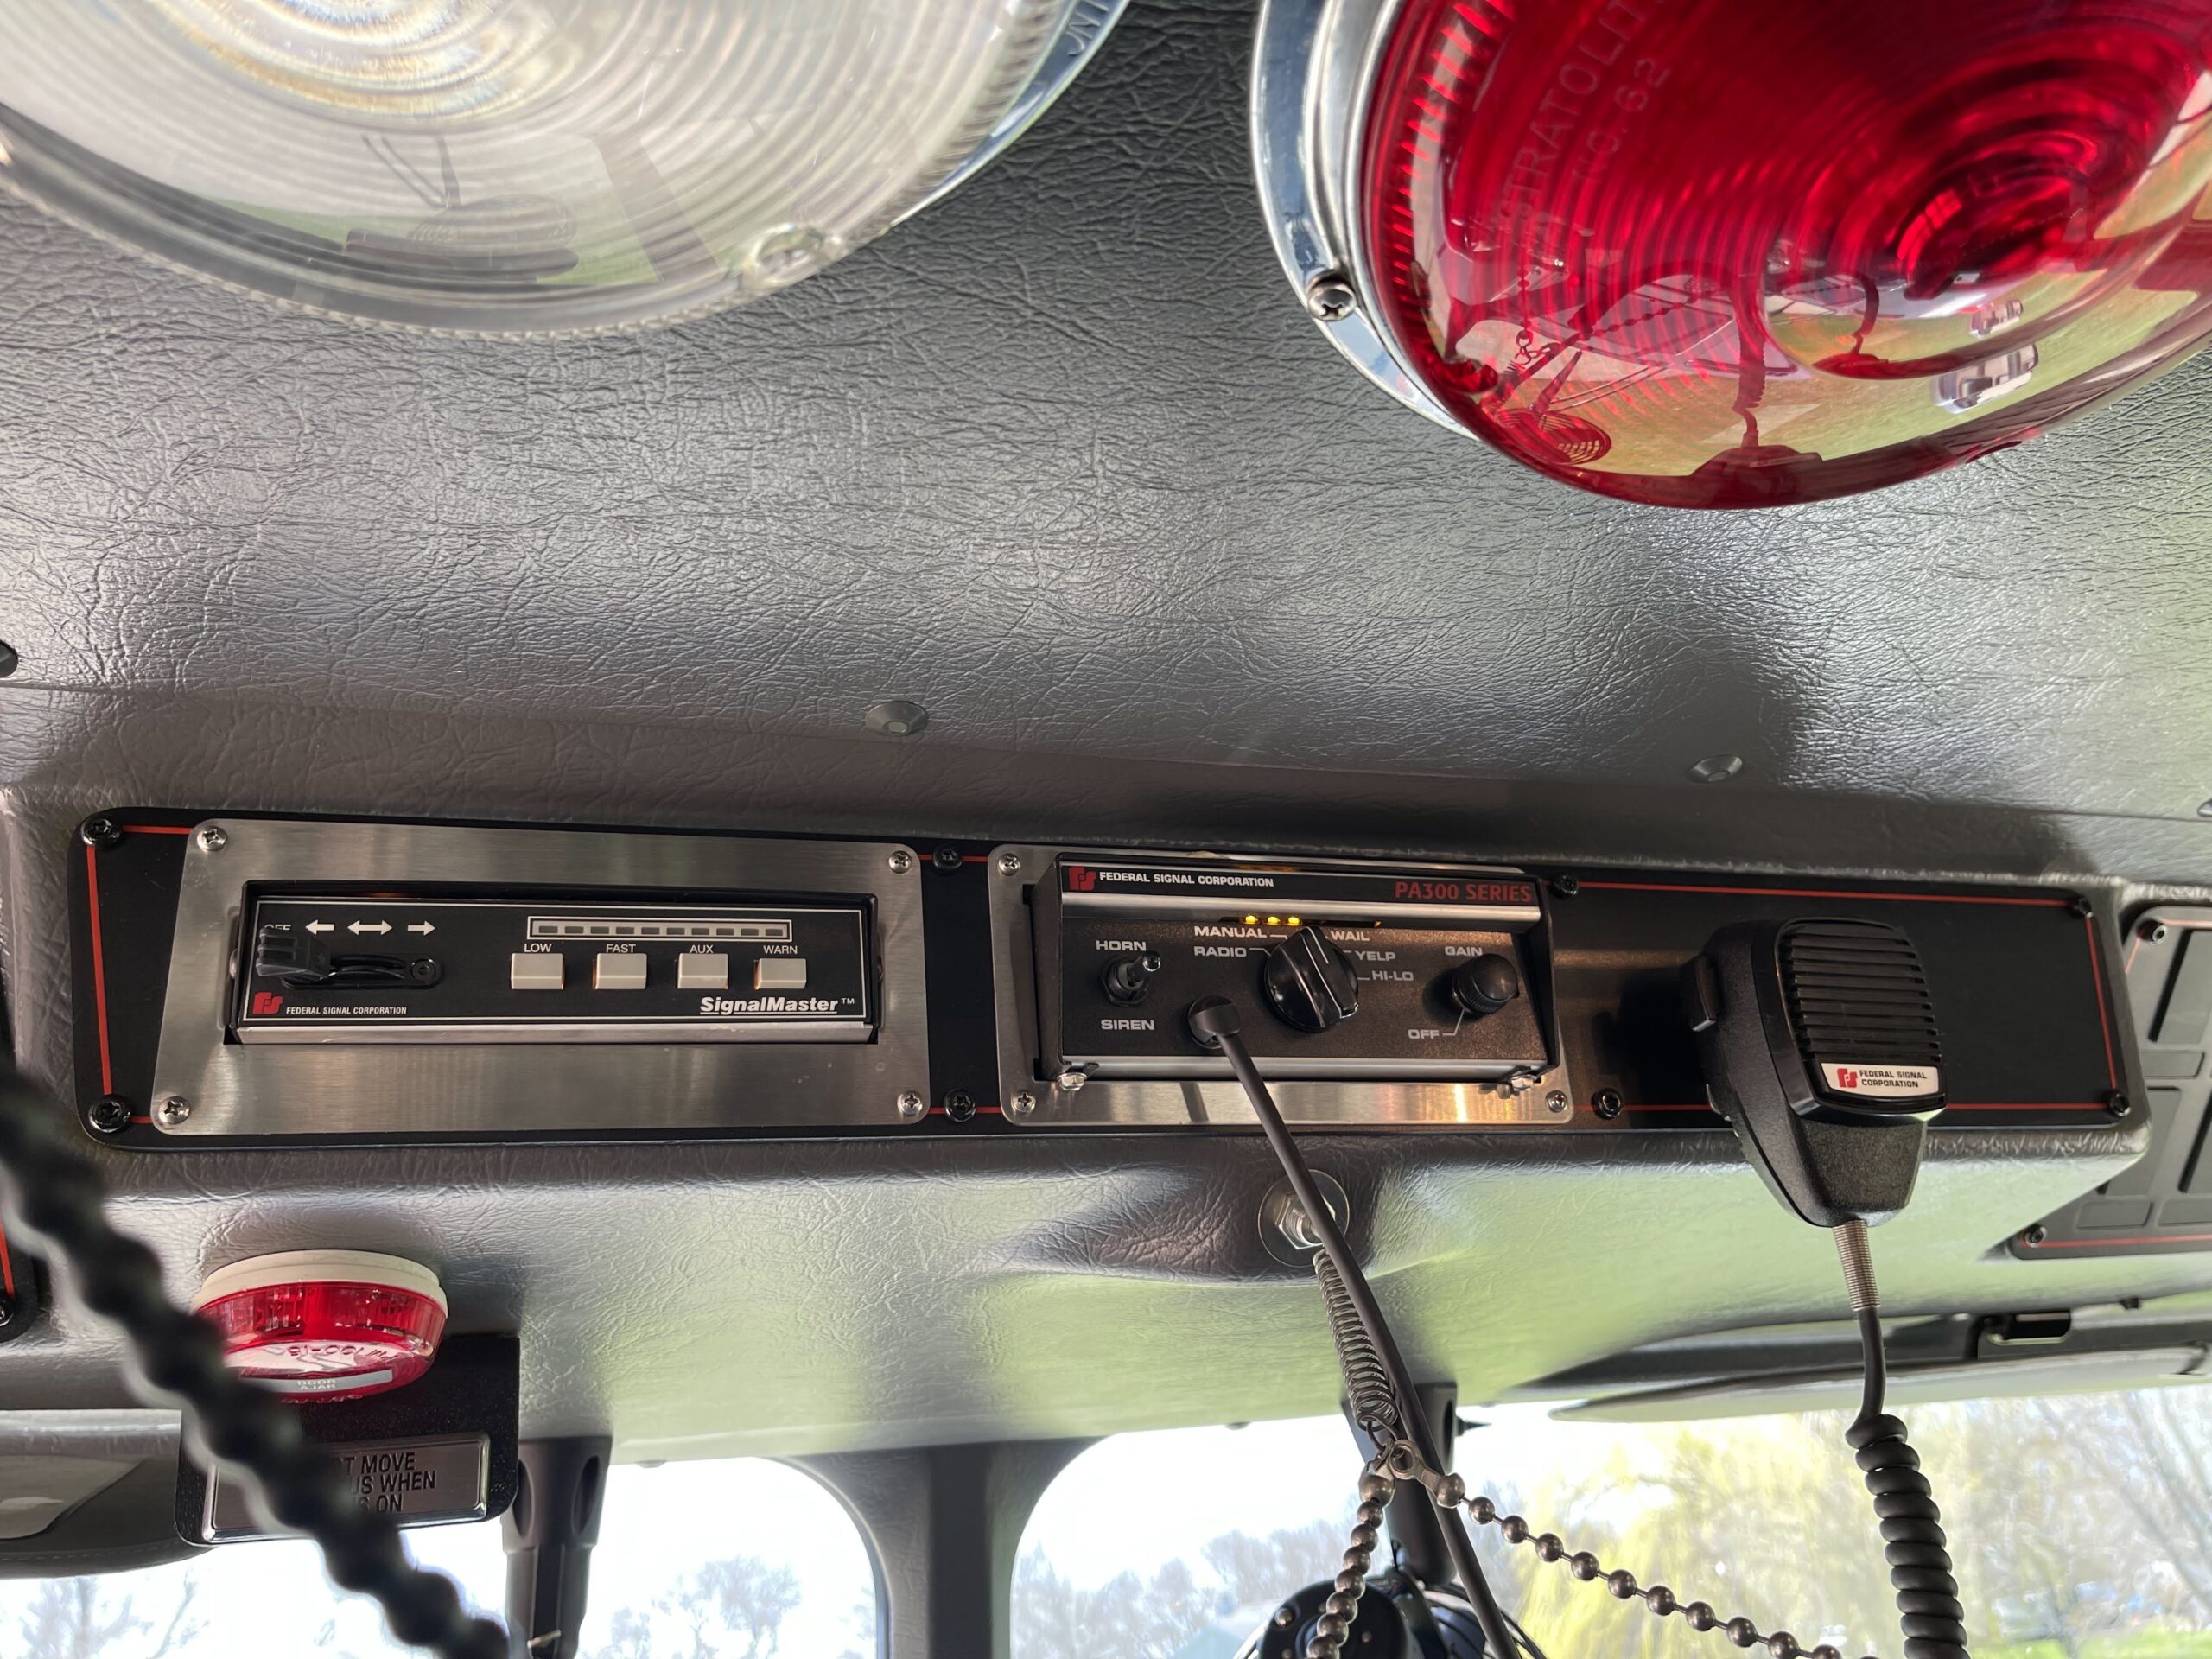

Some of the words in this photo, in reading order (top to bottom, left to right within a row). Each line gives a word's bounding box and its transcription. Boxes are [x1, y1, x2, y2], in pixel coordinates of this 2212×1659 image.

[1099, 871, 1150, 883] FEDERAL
[1154, 874, 1195, 885] SIGNAL
[1198, 875, 1274, 887] CORPORATION
[1394, 880, 1459, 900] PA300
[1465, 883, 1532, 903] SERIES
[1194, 925, 1267, 938] MANUAL
[1331, 930, 1370, 942] WAIL
[524, 943, 552, 953] LOW
[606, 944, 636, 953] FAST
[690, 944, 714, 954] AUX
[763, 945, 798, 955] WARN
[1096, 940, 1147, 951] HORN
[1194, 945, 1247, 957] RADIO
[1444, 945, 1483, 957] GAIN
[1357, 950, 1395, 961] YELP
[1372, 969, 1414, 982] HI-LO
[1101, 1019, 1155, 1031] SIREN
[1408, 1028, 1440, 1039] OFF
[1862, 1079, 1919, 1088] CORPORATION
[361, 1452, 416, 1474] MOVE
[380, 1471, 435, 1492] WHEN
[377, 1493, 403, 1512] ON
